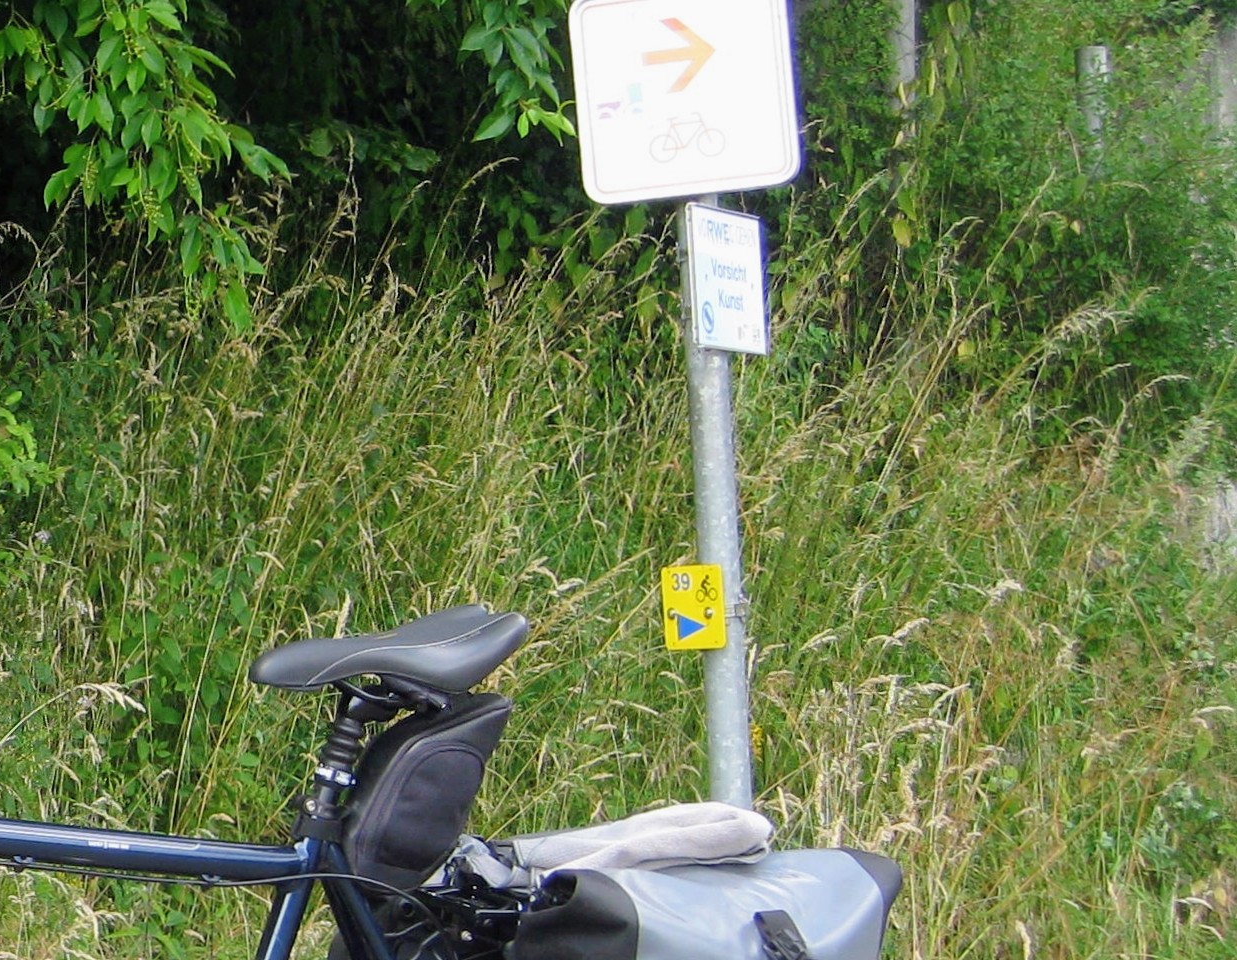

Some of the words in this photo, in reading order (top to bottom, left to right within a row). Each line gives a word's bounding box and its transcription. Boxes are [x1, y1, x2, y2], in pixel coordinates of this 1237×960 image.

[711, 258, 747, 283] Vorsicht
[718, 289, 744, 312] Kunst
[672, 572, 690, 592] 39
